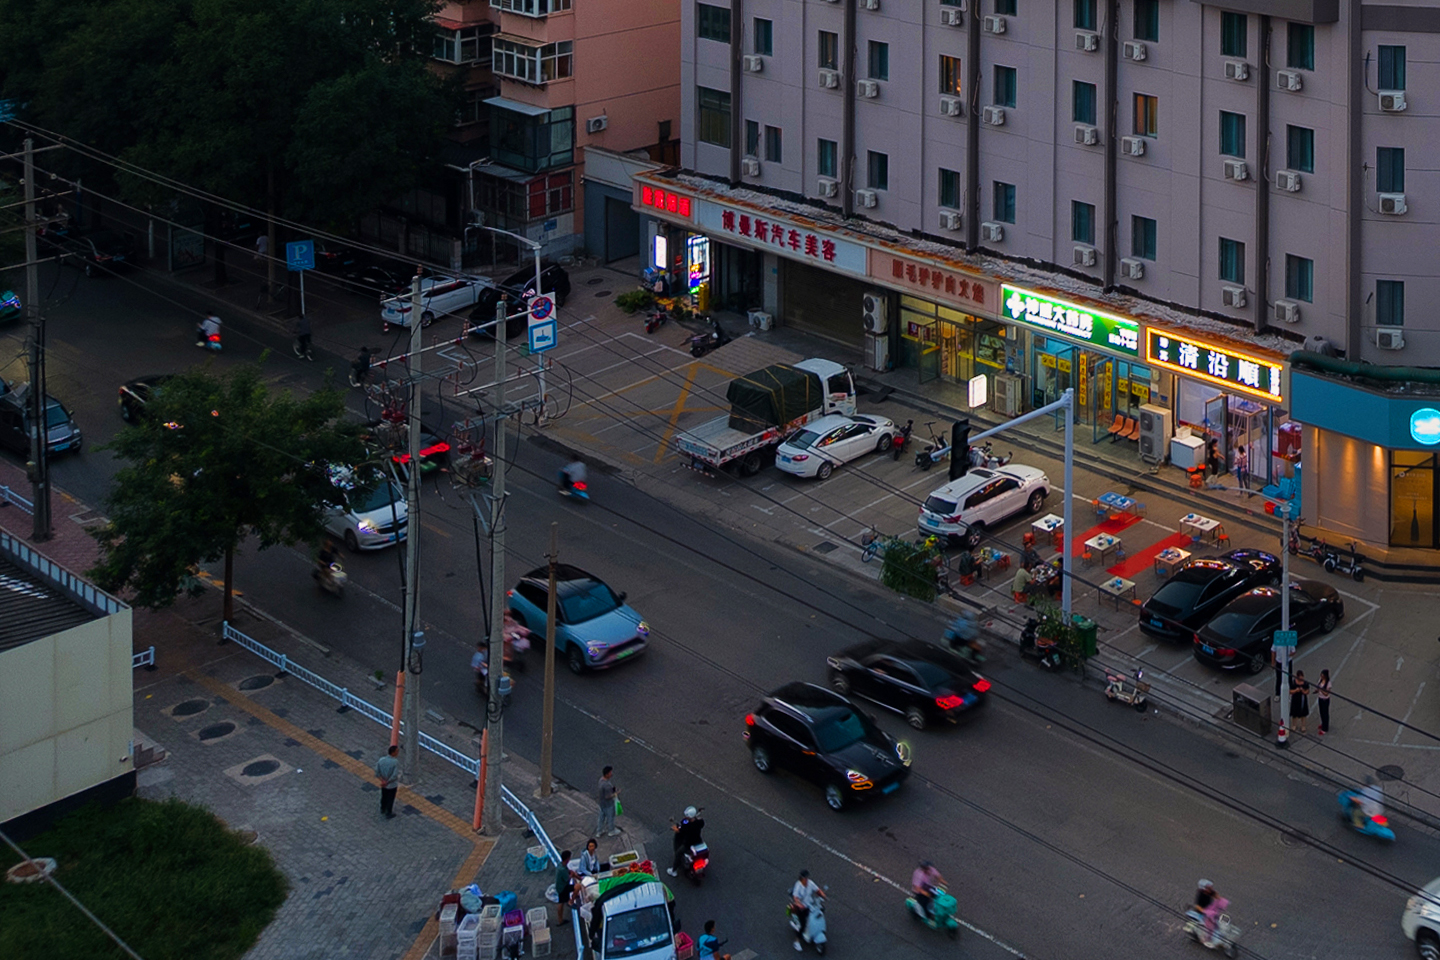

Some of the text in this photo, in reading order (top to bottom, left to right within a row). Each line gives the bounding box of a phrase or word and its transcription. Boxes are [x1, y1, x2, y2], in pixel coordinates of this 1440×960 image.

[721, 209, 836, 262] 博曼斯汽车美容
